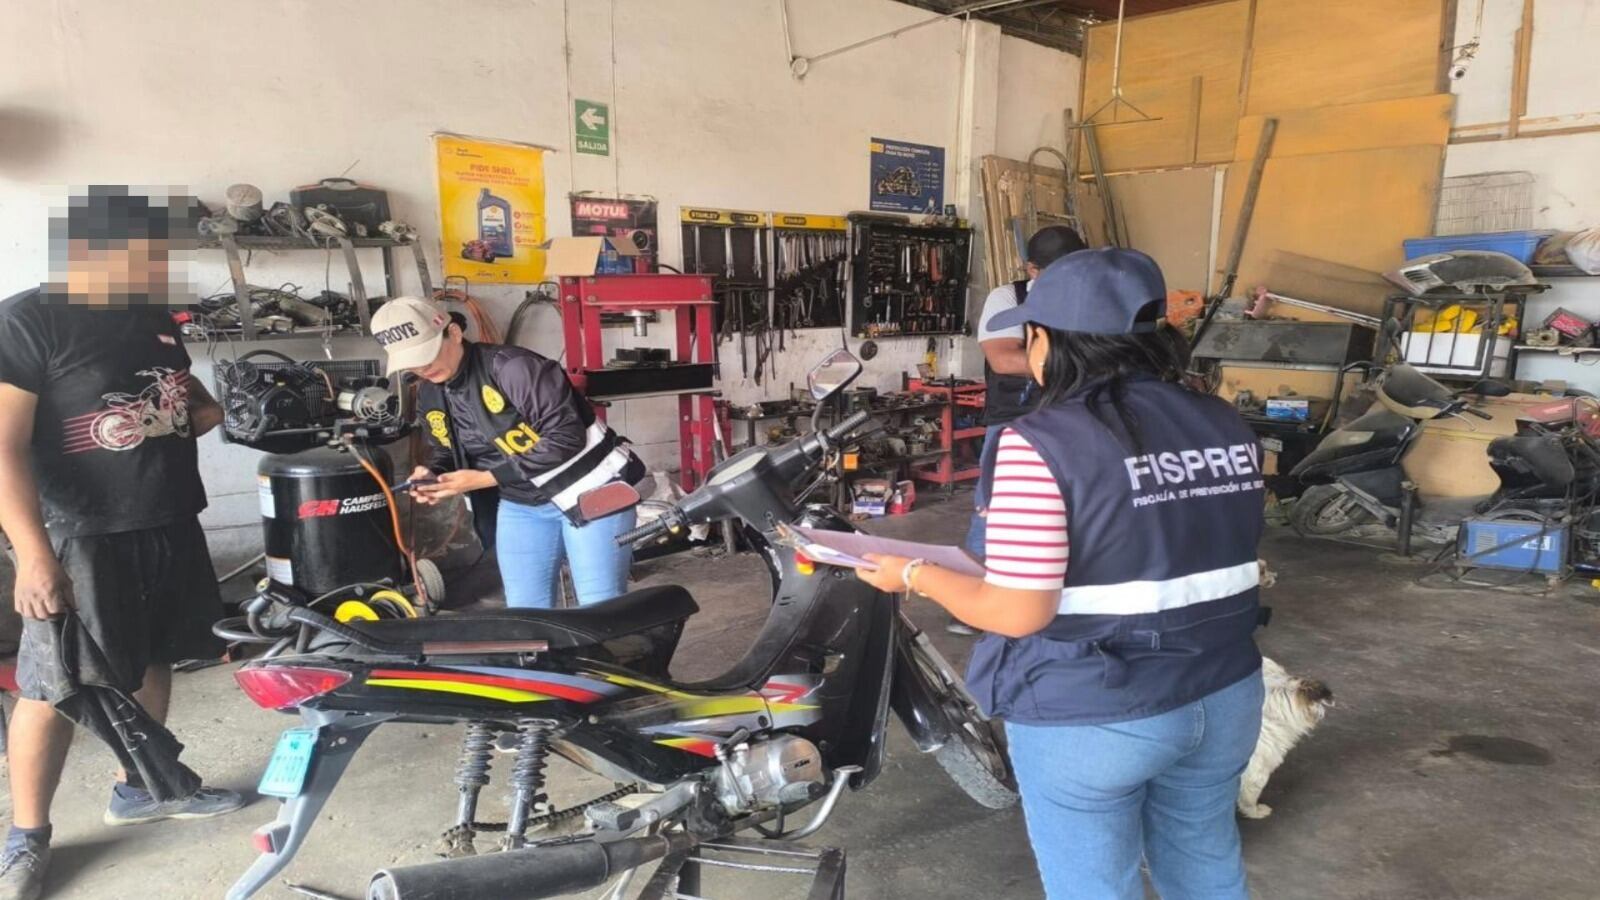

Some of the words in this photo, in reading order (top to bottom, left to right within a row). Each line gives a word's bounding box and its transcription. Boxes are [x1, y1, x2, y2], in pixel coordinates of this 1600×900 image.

[577, 140, 607, 151] SALIDA
[577, 203, 627, 217] MOTUL
[1178, 490, 1188, 499] DE
